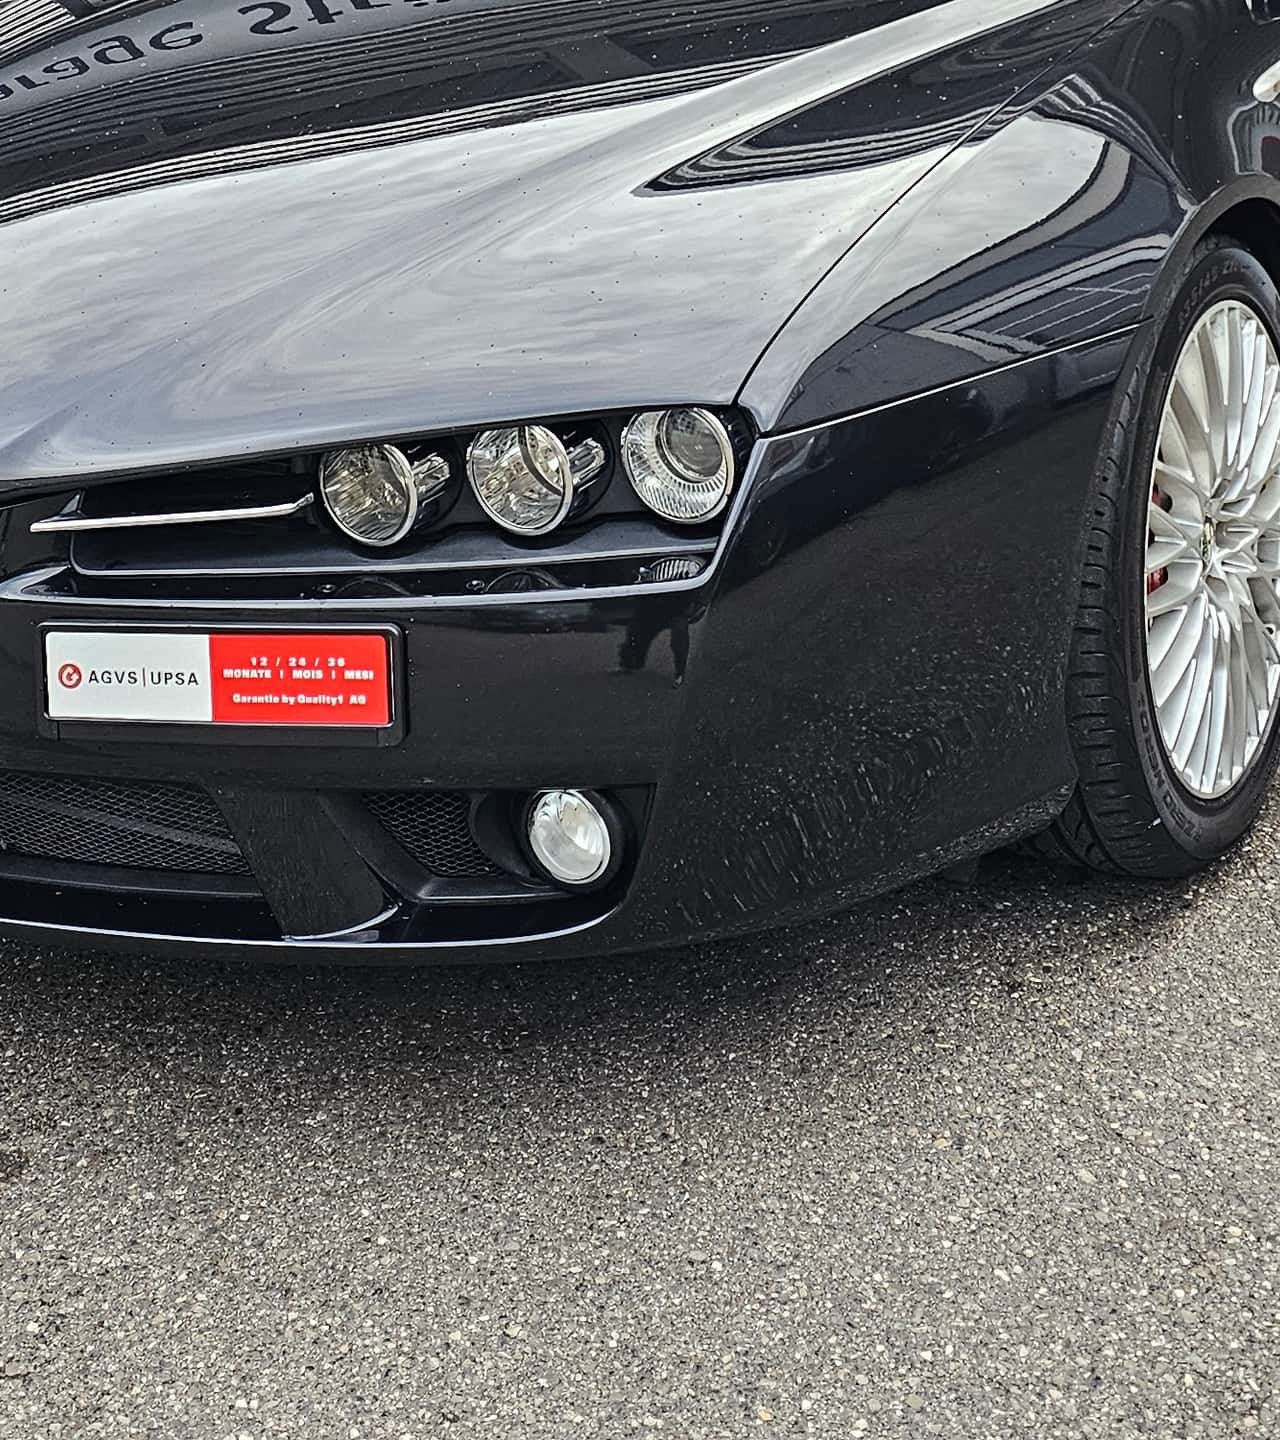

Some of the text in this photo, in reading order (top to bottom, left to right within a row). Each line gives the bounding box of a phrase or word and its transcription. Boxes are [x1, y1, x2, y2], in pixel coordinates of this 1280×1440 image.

[250, 656, 268, 666] 12
[288, 657, 307, 667] 24
[327, 657, 346, 667] 36
[222, 668, 273, 680] MONATE
[291, 669, 324, 680] MOIS
[343, 670, 375, 681] MESI
[232, 693, 280, 704] Garantie
[281, 693, 297, 705] by
[349, 695, 367, 705] AG
